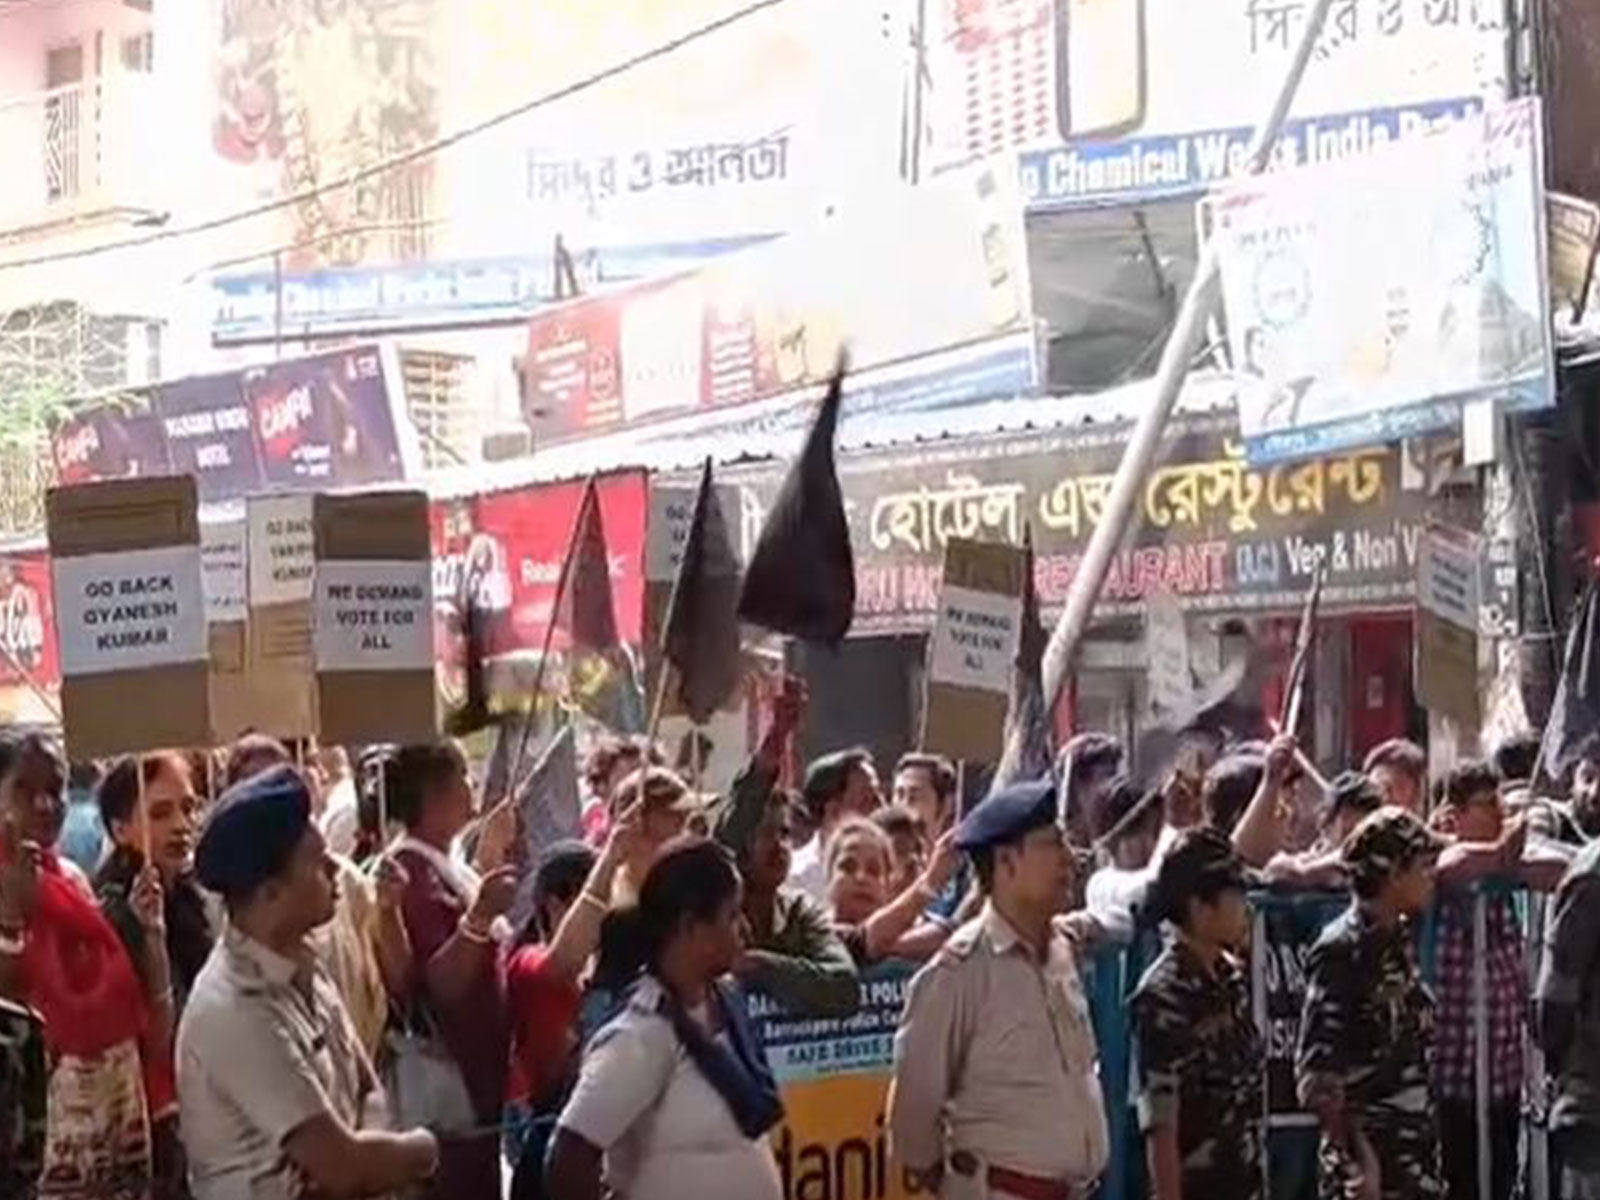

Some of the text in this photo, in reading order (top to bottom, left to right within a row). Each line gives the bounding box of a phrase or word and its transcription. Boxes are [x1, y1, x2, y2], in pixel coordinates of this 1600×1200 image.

[1048, 139, 1190, 194] Chemical
[870, 460, 1026, 551] হোটেল
[1332, 530, 1349, 571] &
[119, 575, 174, 595] BACK
[335, 609, 378, 626] VOTE
[96, 628, 169, 651] KUMAR
[361, 633, 392, 650] ALL
